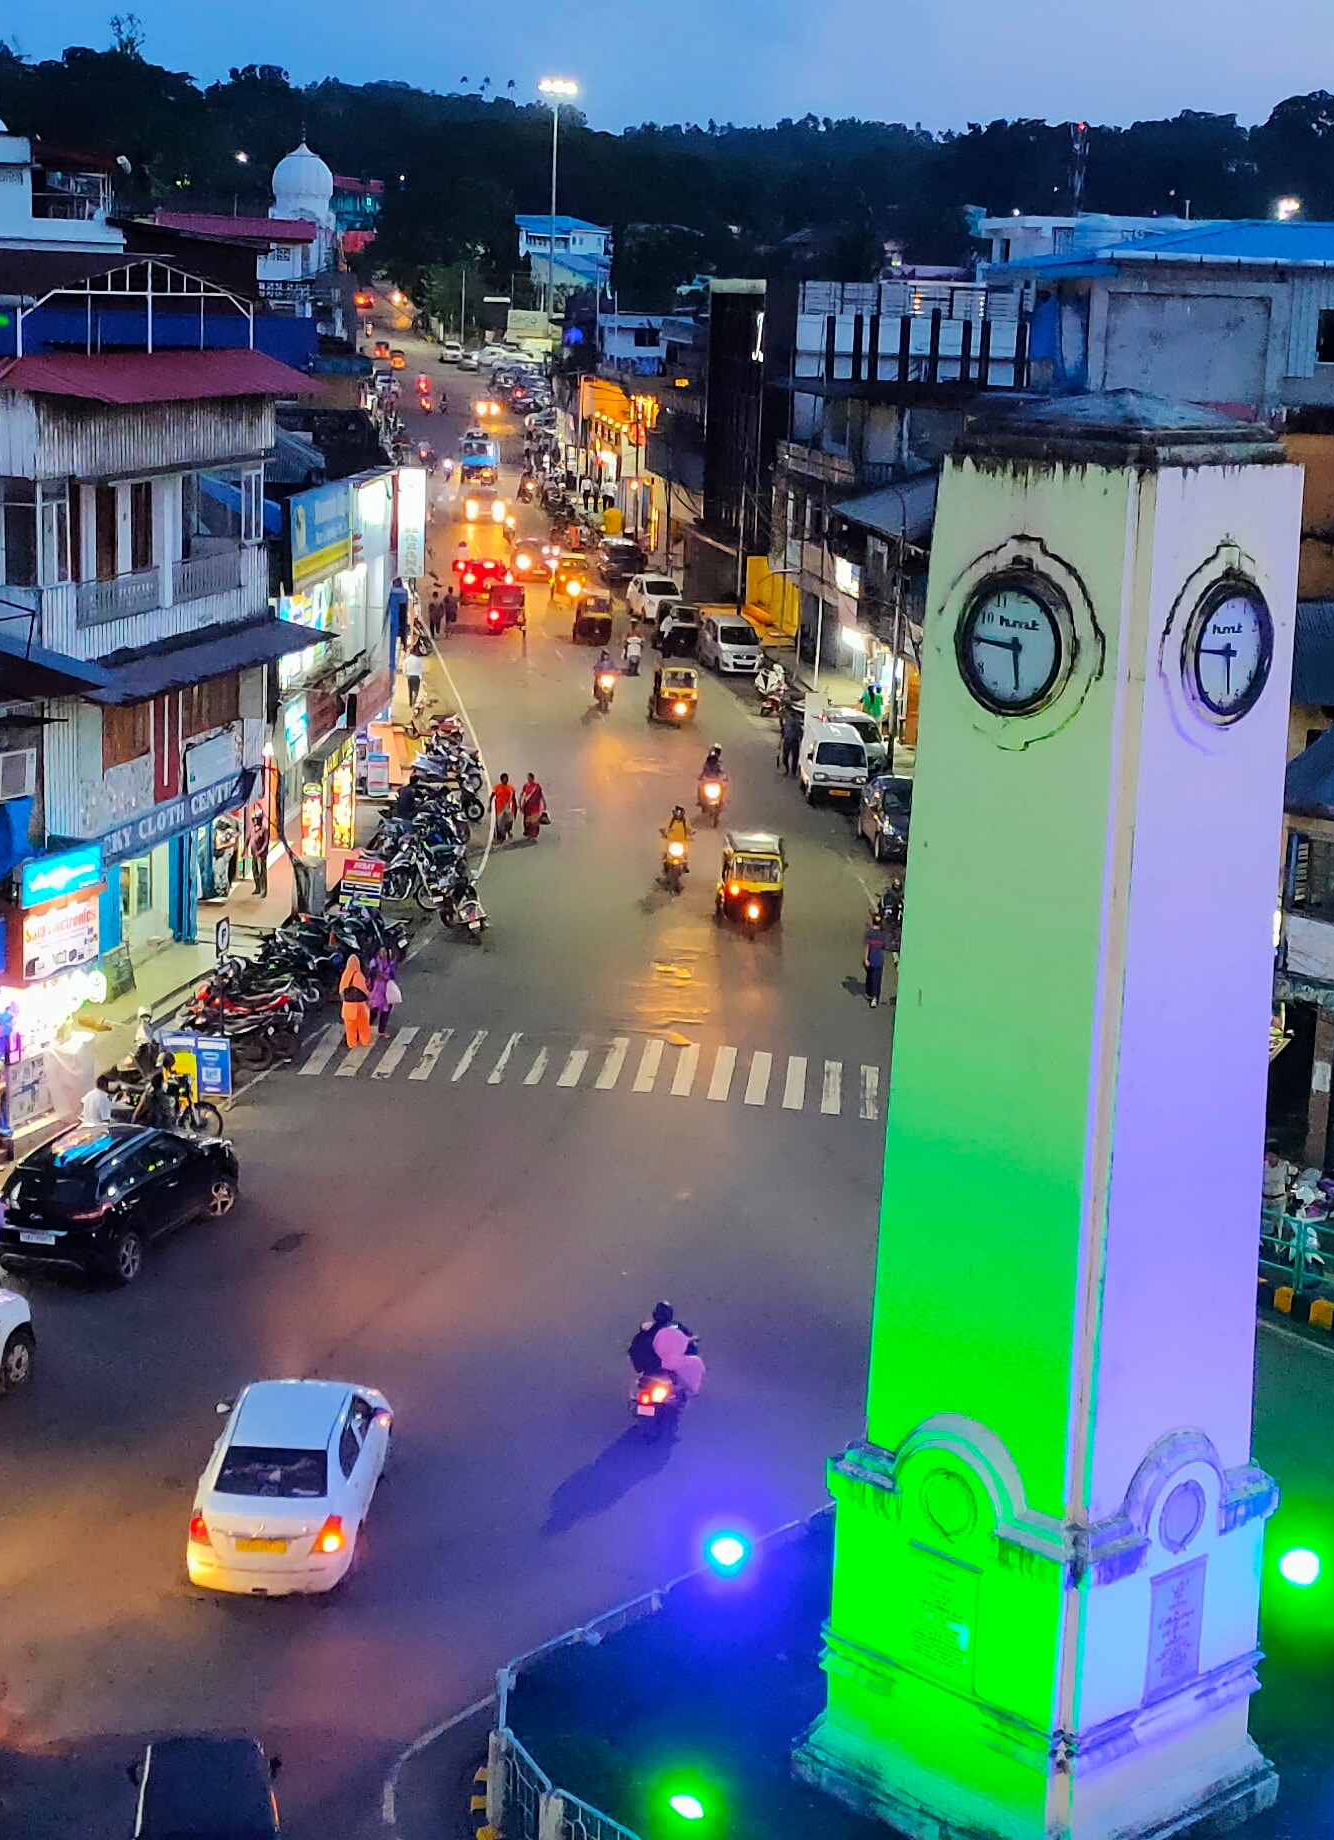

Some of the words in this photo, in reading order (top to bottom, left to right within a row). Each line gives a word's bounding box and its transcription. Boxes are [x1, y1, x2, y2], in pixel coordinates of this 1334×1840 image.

[981, 611, 995, 625] 10
[999, 615, 1040, 631] hmt
[1213, 622, 1244, 635] hmt
[138, 801, 186, 841] CLOTH
